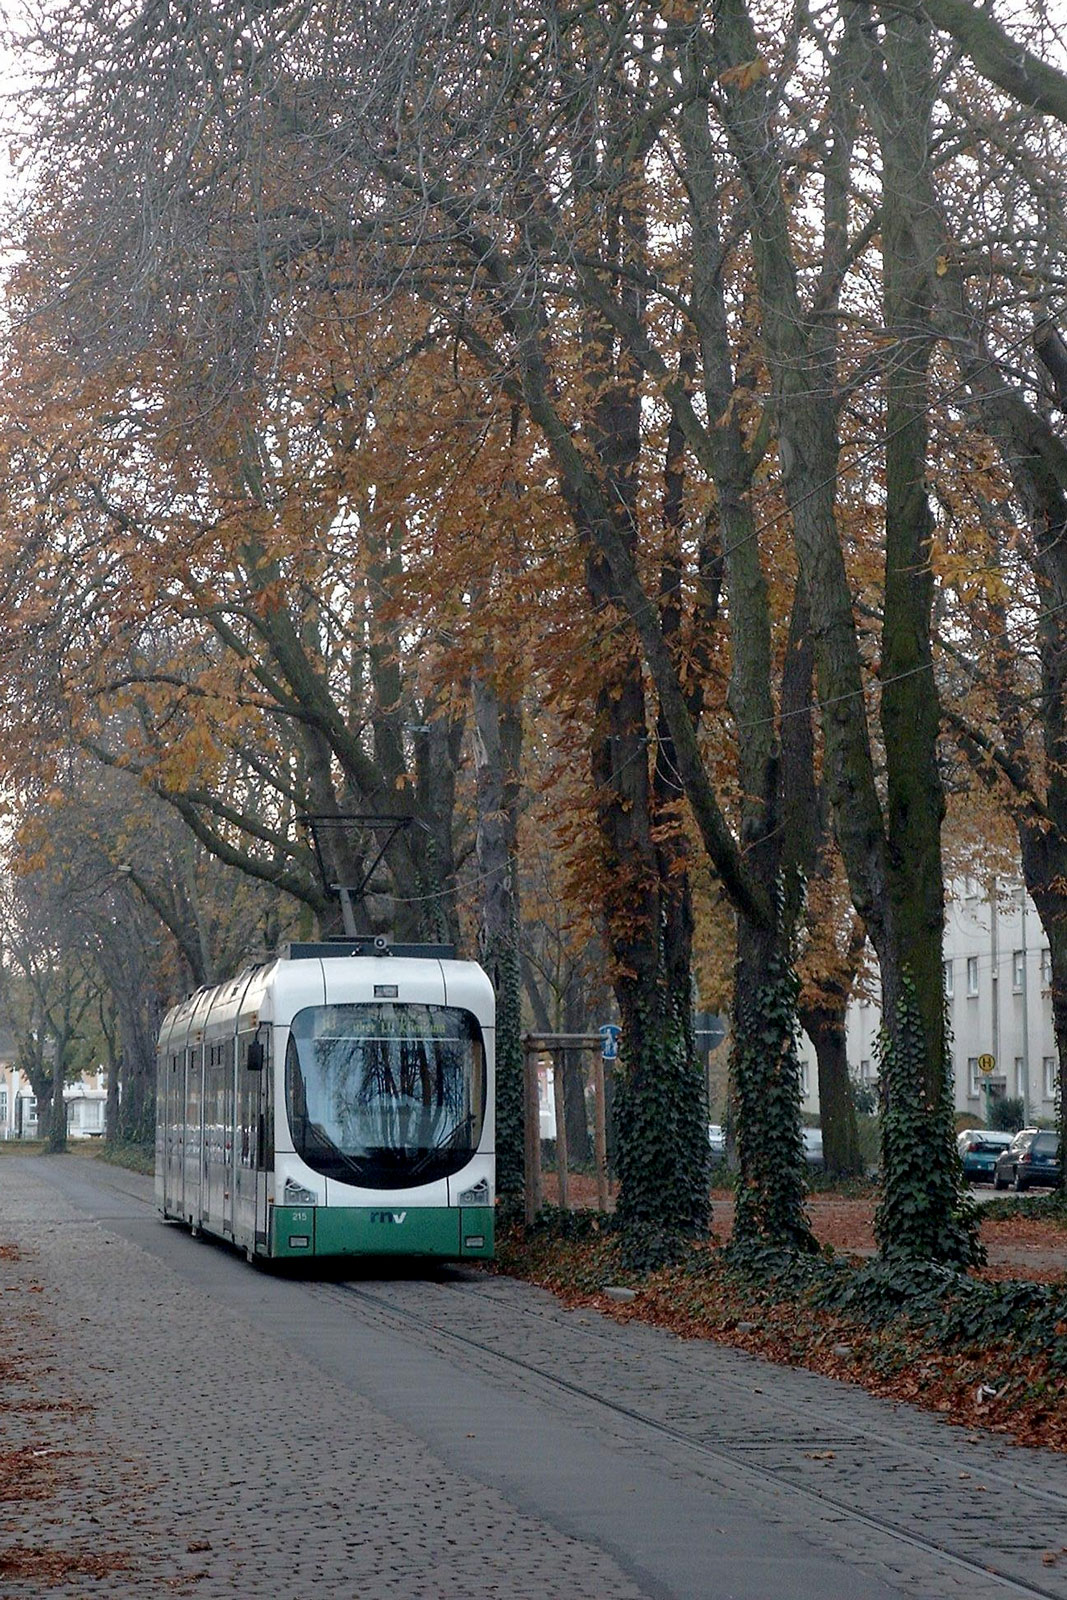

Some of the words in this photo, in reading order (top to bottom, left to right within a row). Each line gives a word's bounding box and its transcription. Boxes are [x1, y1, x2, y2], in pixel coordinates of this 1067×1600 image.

[982, 1057, 992, 1068] H
[292, 1212, 307, 1221] 215
[370, 1211, 407, 1224] rnv
